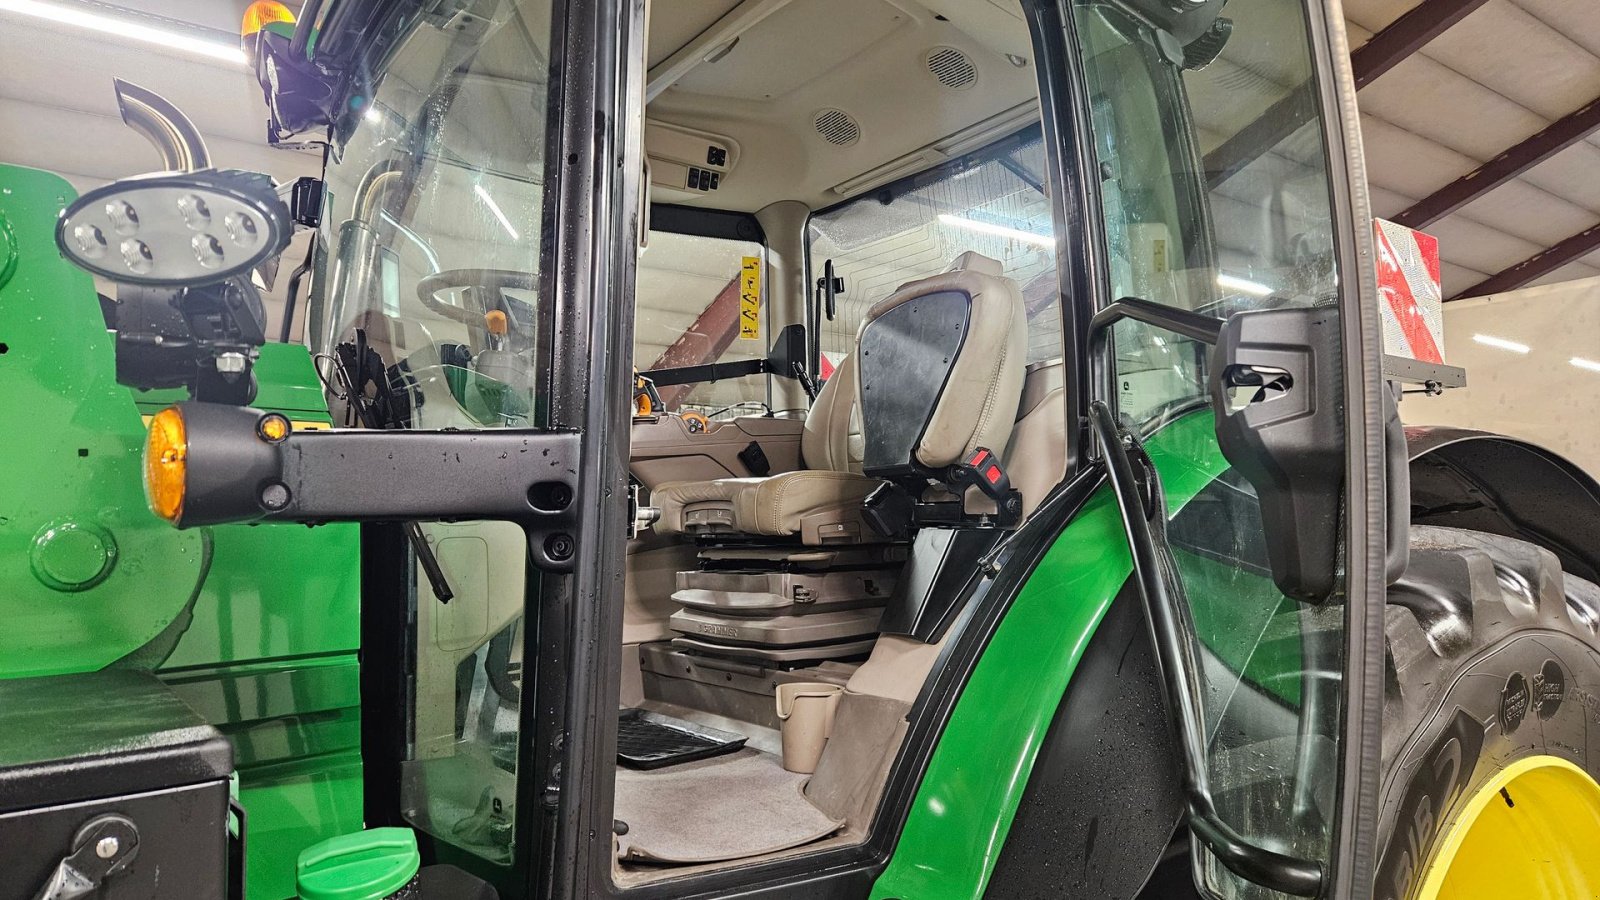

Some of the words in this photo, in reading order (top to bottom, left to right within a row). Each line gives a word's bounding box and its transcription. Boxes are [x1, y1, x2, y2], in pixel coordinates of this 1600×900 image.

[704, 624, 738, 637] GRAMMER
[1389, 795, 1433, 900] BIB
[1434, 737, 1462, 834] 2
